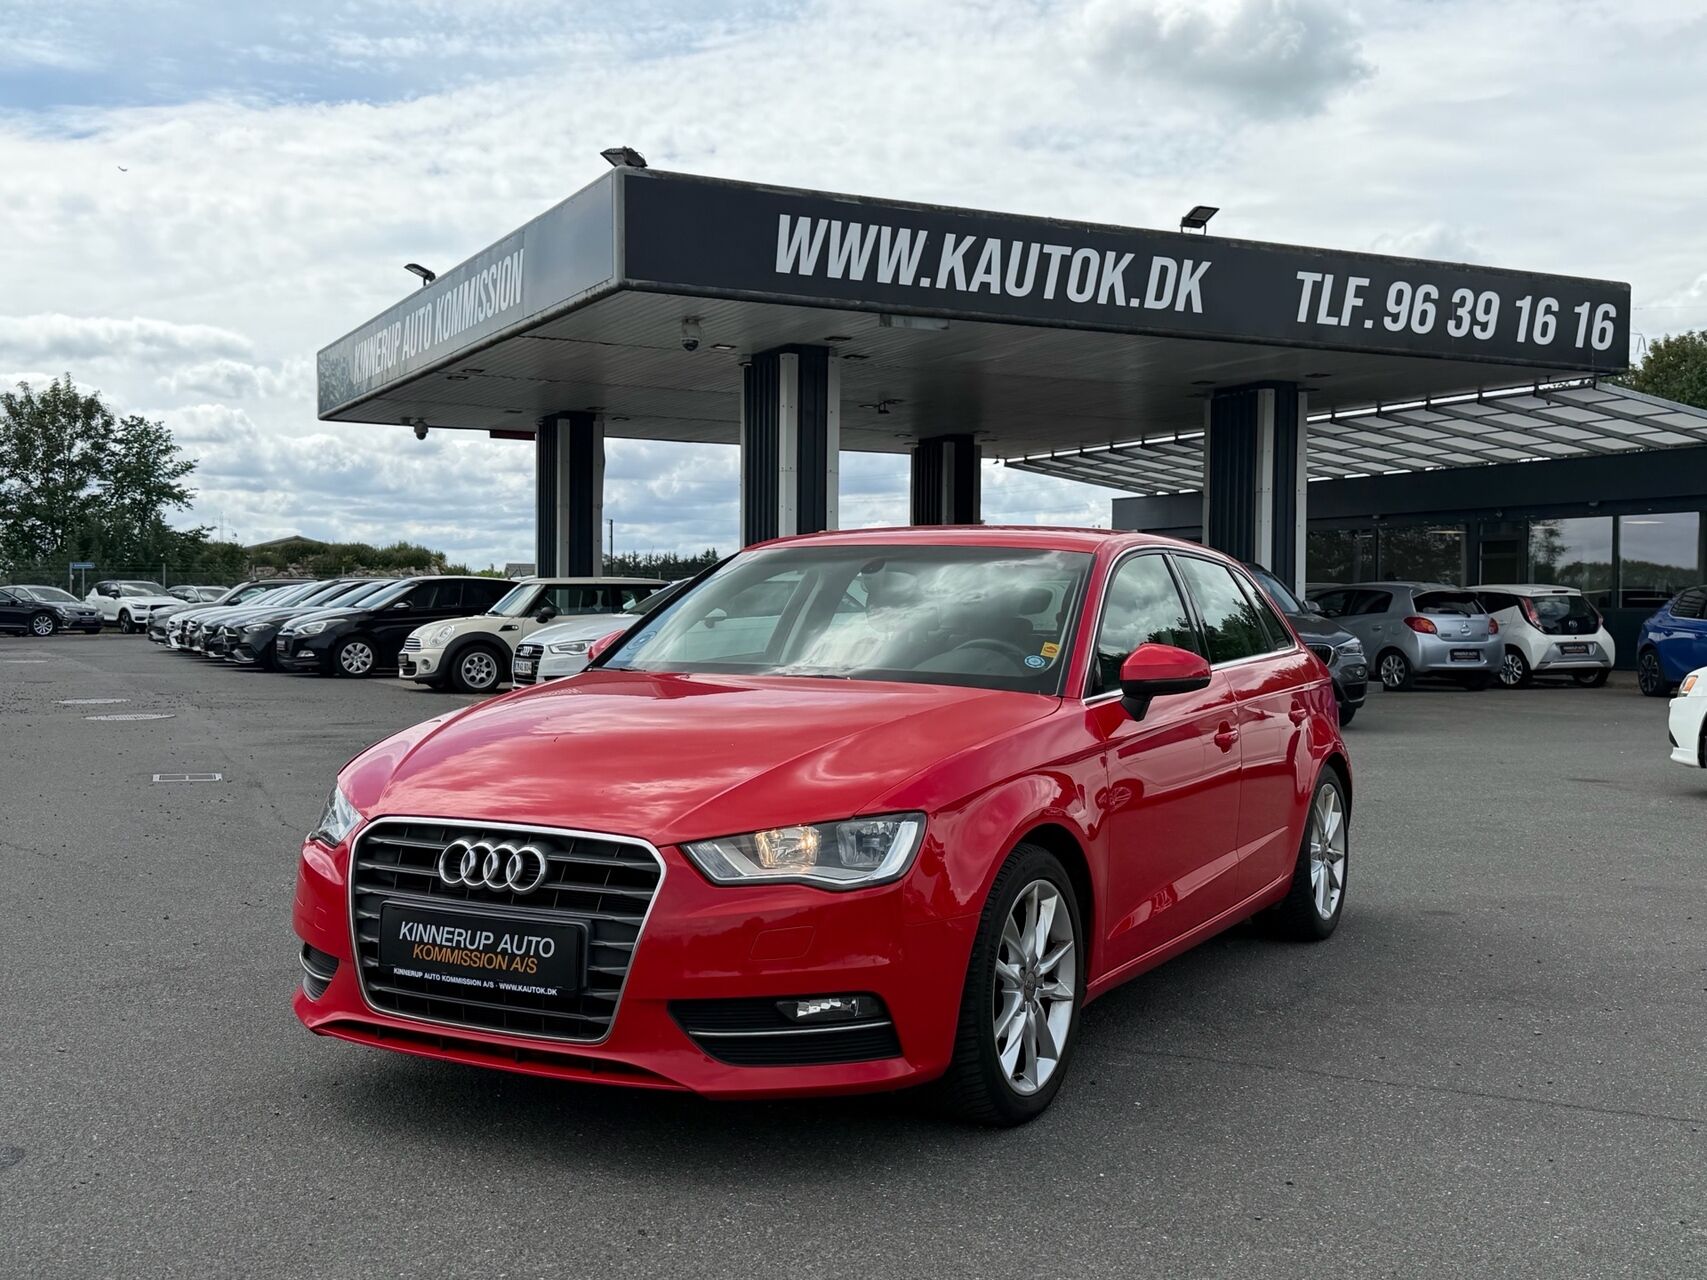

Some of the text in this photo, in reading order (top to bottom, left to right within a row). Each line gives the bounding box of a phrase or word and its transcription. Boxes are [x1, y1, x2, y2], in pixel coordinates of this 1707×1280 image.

[775, 214, 1213, 314] WWW.KAUTOK.DK
[353, 248, 525, 384] KINNERUP AUTO KOMMISSION
[1296, 271, 1617, 351] TLF. 96 39 16 16
[399, 921, 555, 958] KINNERUP AUTO
[412, 944, 538, 974] KOMMISSION A/S
[393, 967, 423, 979] KINNERUP
[424, 972, 441, 981] AUTO
[442, 974, 482, 987] KOMMISSION
[483, 980, 494, 989] A/S
[499, 982, 558, 996] WWW.KAUTOK.DK
